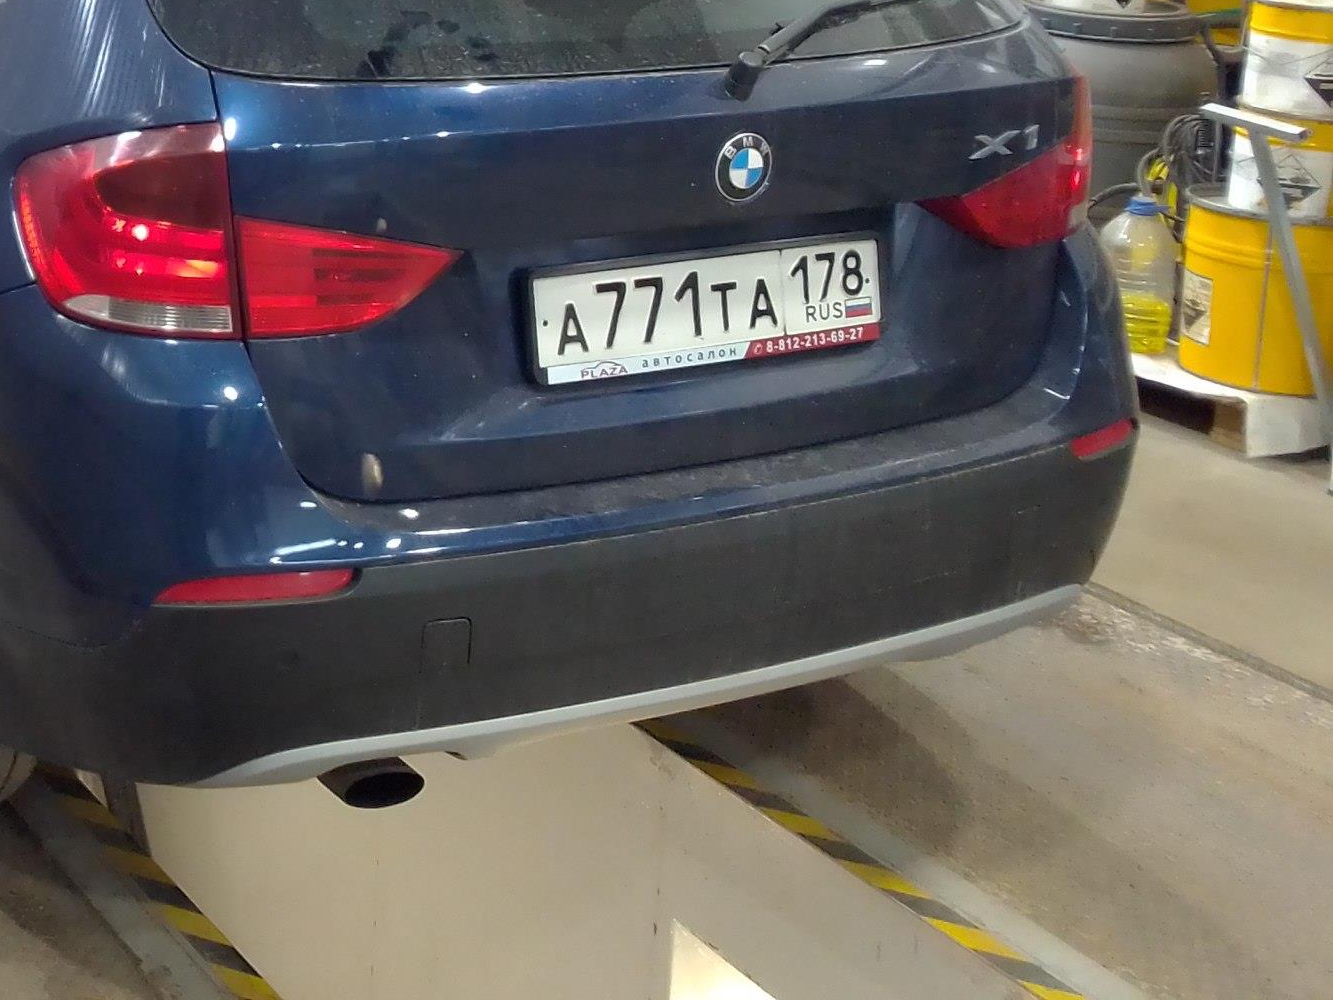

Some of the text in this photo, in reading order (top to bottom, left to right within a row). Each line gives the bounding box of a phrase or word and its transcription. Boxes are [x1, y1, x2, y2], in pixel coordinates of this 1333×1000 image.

[724, 136, 769, 159] BMW
[968, 124, 1040, 160] X1
[789, 249, 863, 304] 178
[805, 302, 844, 324] RUS
[766, 326, 865, 354] 8-812-213-69-27
[642, 348, 737, 368] автосалон
[580, 364, 629, 379] PLAZA
